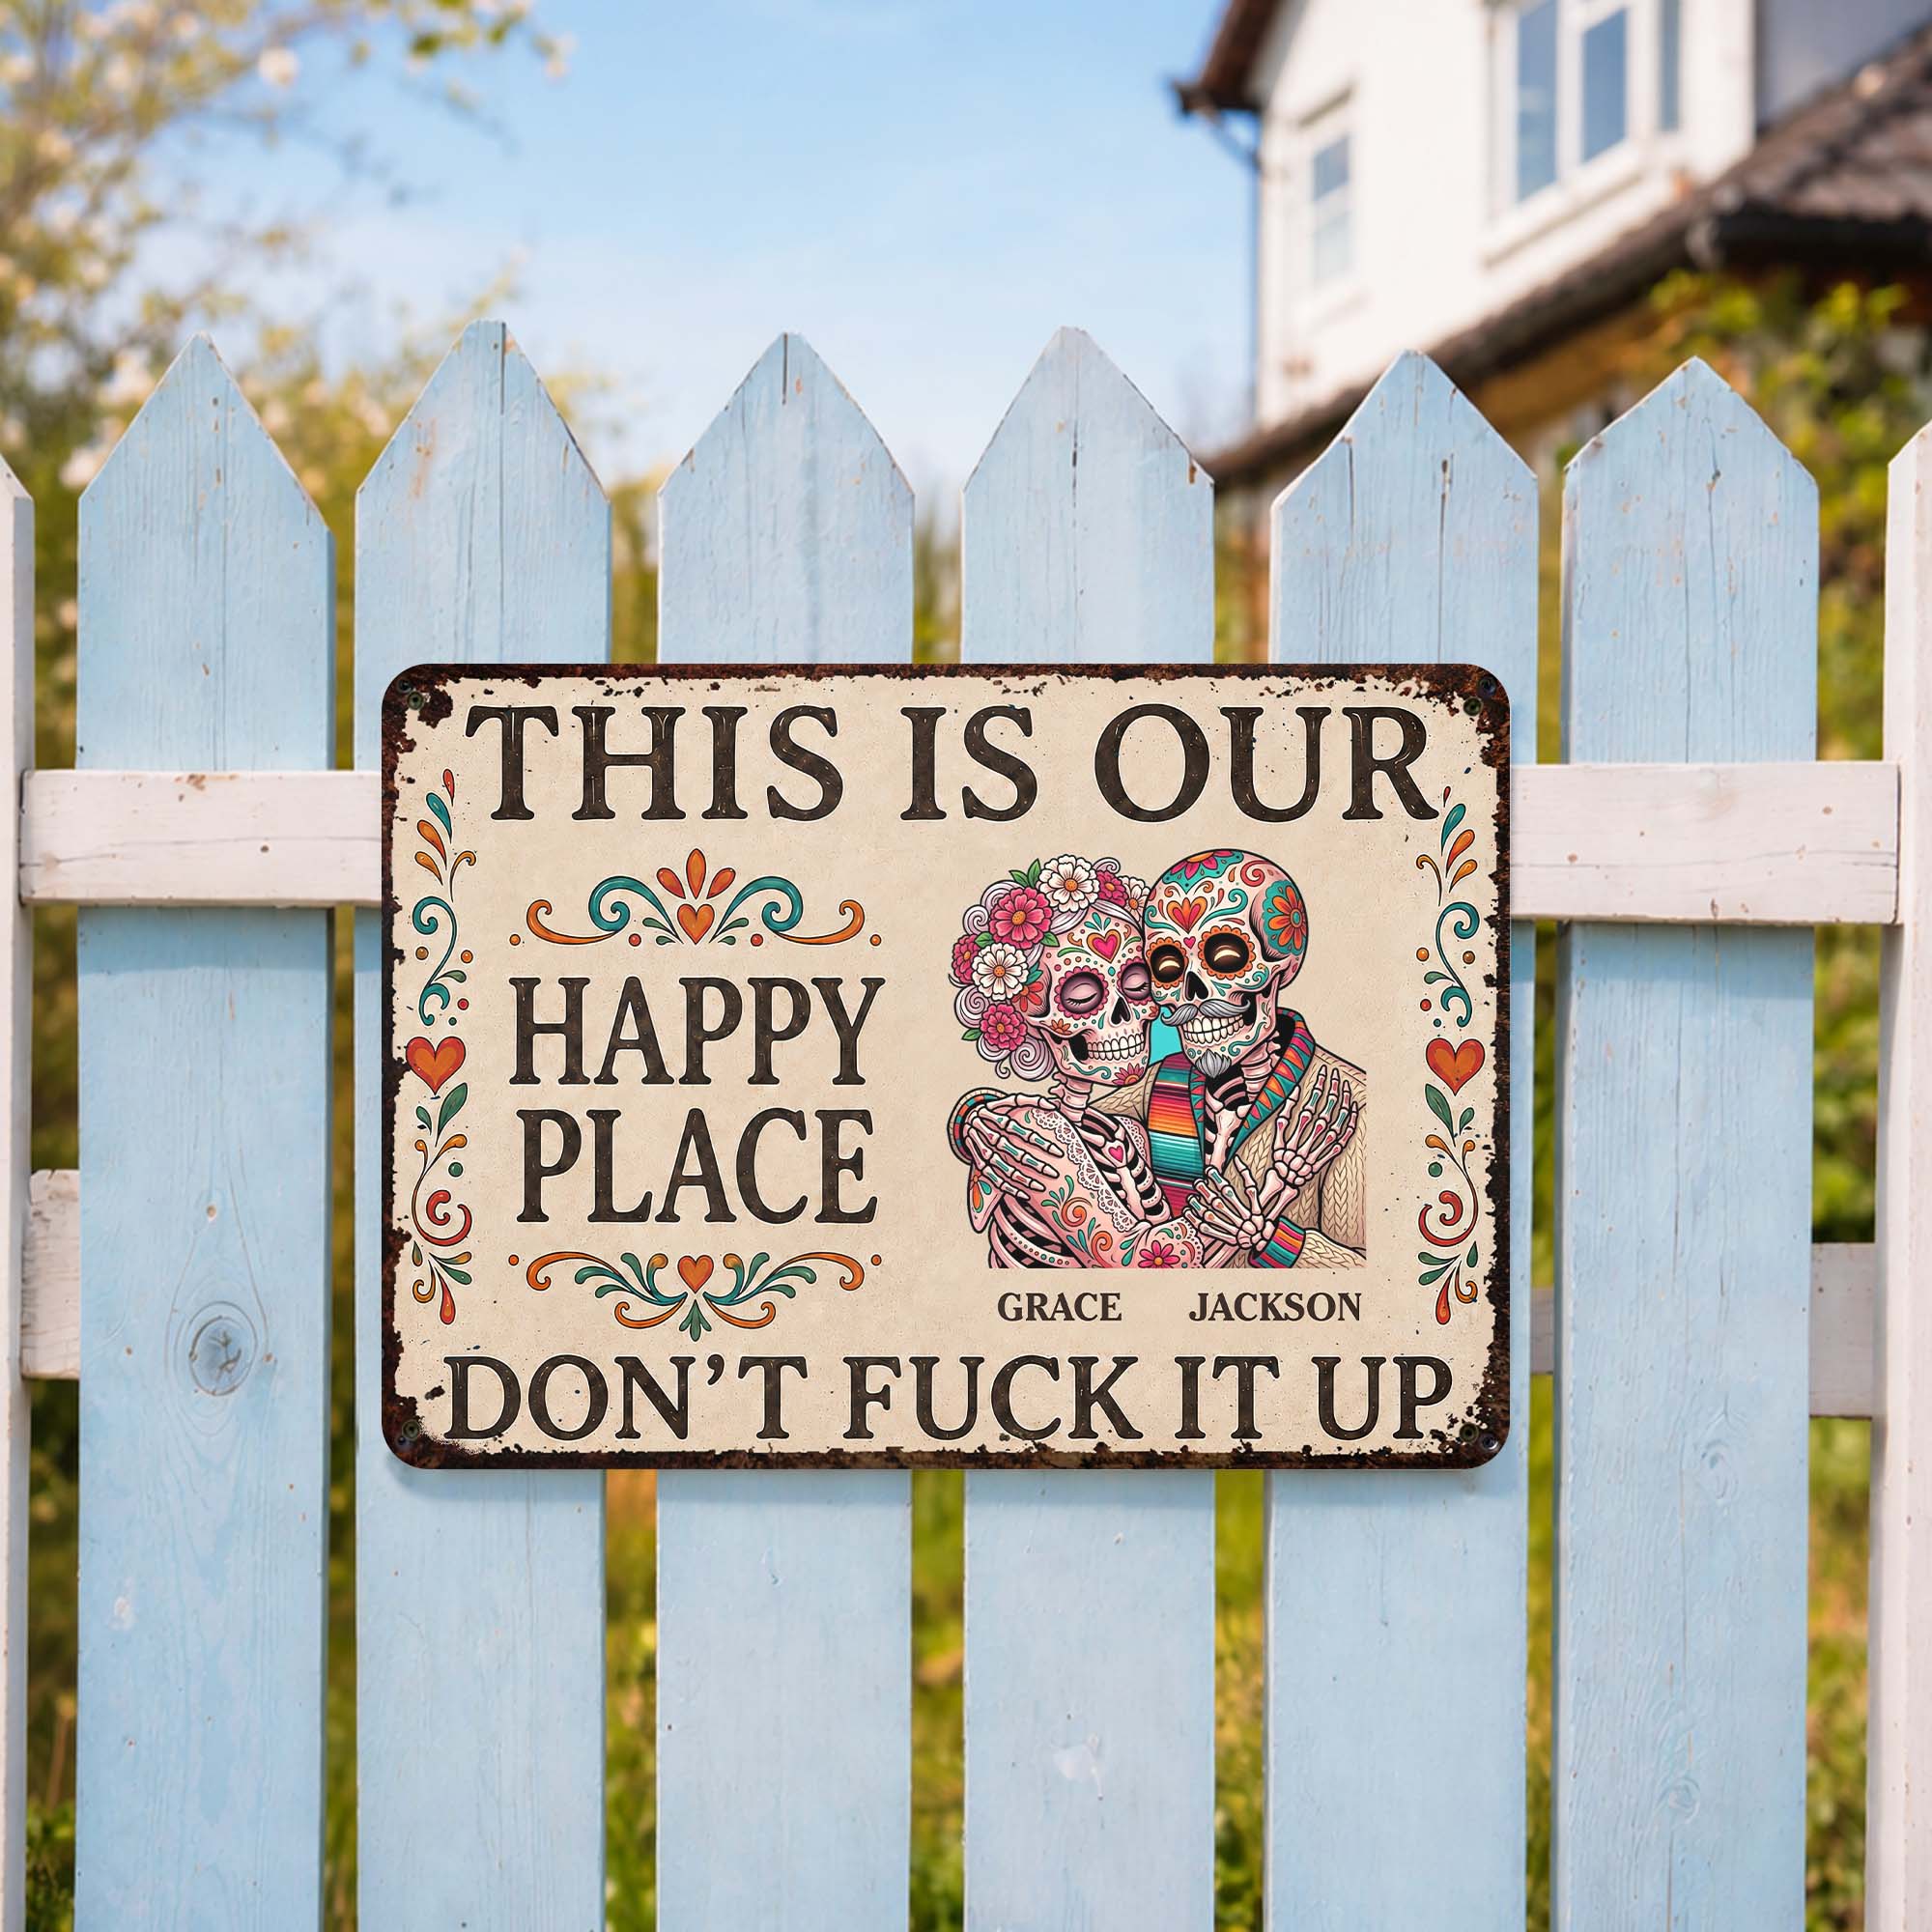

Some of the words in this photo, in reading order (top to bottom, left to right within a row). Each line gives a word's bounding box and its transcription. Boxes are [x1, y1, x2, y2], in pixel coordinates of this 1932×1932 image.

[466, 704, 843, 821] THIS
[899, 704, 1038, 821] IS
[1094, 703, 1439, 822] OUR
[509, 976, 886, 1085] HAPPY
[516, 1107, 877, 1224] PLACE
[997, 1292, 1122, 1321] GRACE
[1188, 1292, 1362, 1321] JACKSON
[443, 1354, 809, 1440] DON’T
[842, 1355, 1144, 1441] FUCK
[1174, 1355, 1280, 1440] IT
[1310, 1355, 1453, 1440] UP
